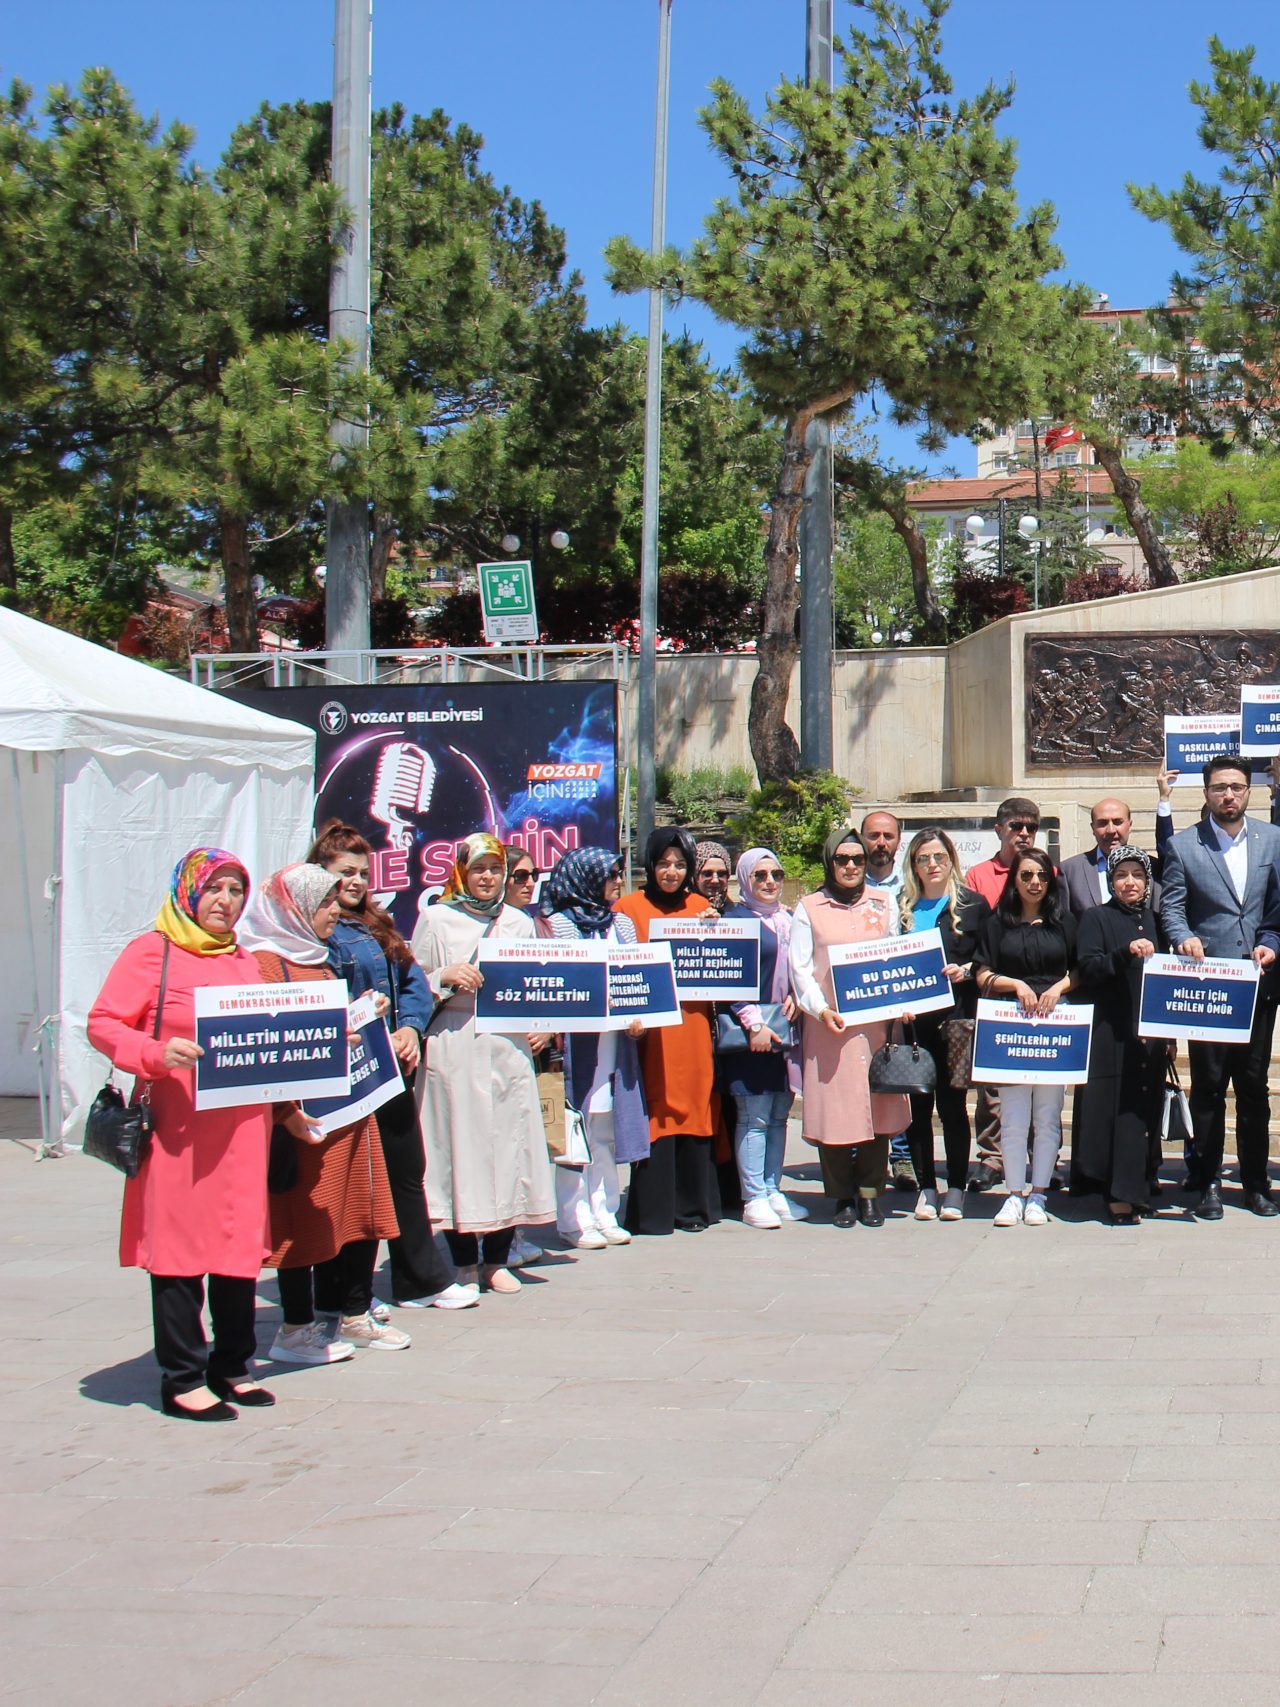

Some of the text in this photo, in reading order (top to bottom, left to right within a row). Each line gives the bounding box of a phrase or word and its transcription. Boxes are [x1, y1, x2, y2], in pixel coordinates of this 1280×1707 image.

[350, 707, 483, 724] YOZGAT BELEDİYESİ
[1178, 742, 1227, 752] BASKILARA
[532, 764, 598, 778] YOZGAT
[528, 780, 564, 802] İÇİN
[957, 841, 982, 853] ARŞI
[676, 946, 727, 957] MİLLİ İRADE
[678, 957, 704, 968] PARTİ
[609, 971, 644, 984] EMOKRASİ
[702, 970, 742, 979] KALDIRDI
[862, 965, 916, 984] BU DAVA
[523, 976, 565, 988] YETER
[845, 975, 938, 1001] MİLLET DAVASI
[495, 989, 590, 1002] SÖZ MİLLETİN!
[1173, 987, 1228, 1003] MİLLET İÇİN
[1165, 1000, 1233, 1015] VERİLEN ÖMÜR
[210, 1026, 338, 1049] MİLLETİN MAYASI
[994, 1032, 1072, 1046] ŞEHİTLERİN PİRİ
[216, 1046, 332, 1069] İMAN VE AHLAK
[1007, 1047, 1058, 1059] MENDERES
[351, 1063, 371, 1086] ERSE
